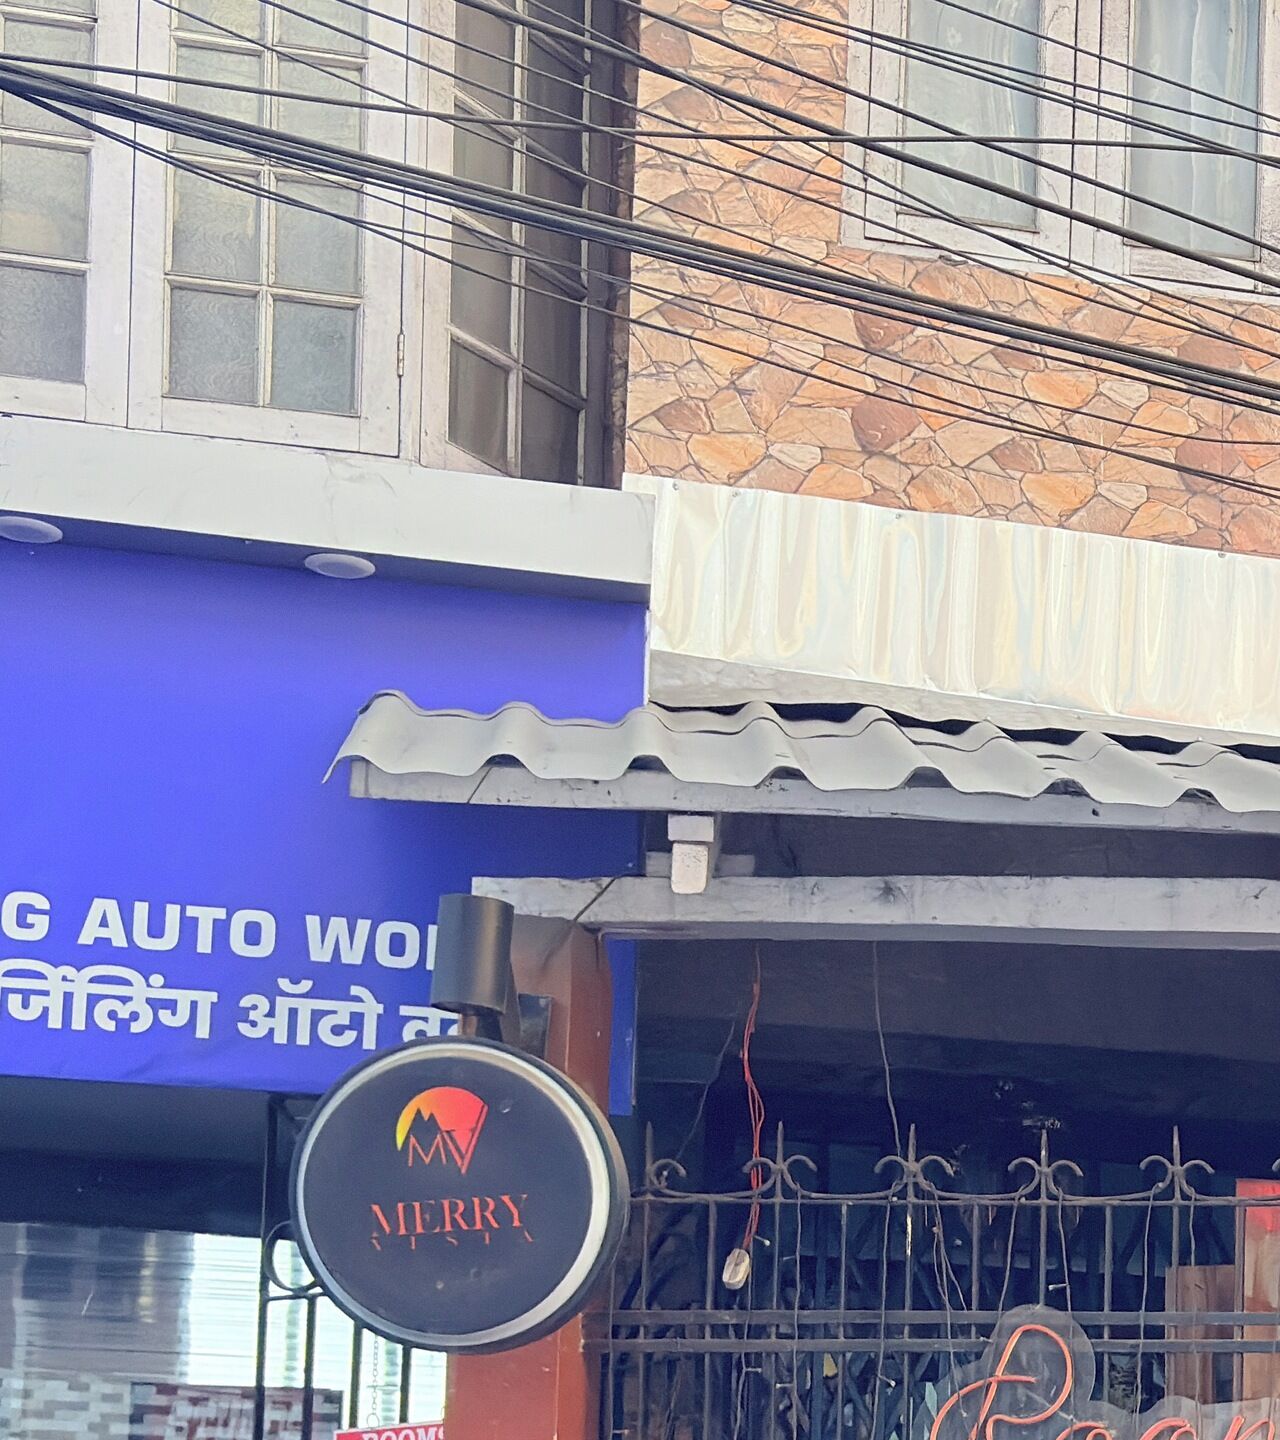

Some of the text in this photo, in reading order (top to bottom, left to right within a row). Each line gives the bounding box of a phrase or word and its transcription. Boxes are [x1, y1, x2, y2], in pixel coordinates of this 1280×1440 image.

[77, 897, 277, 958] AUTO
[237, 977, 384, 1050] ऑटो
[370, 1193, 529, 1236] MERRY
